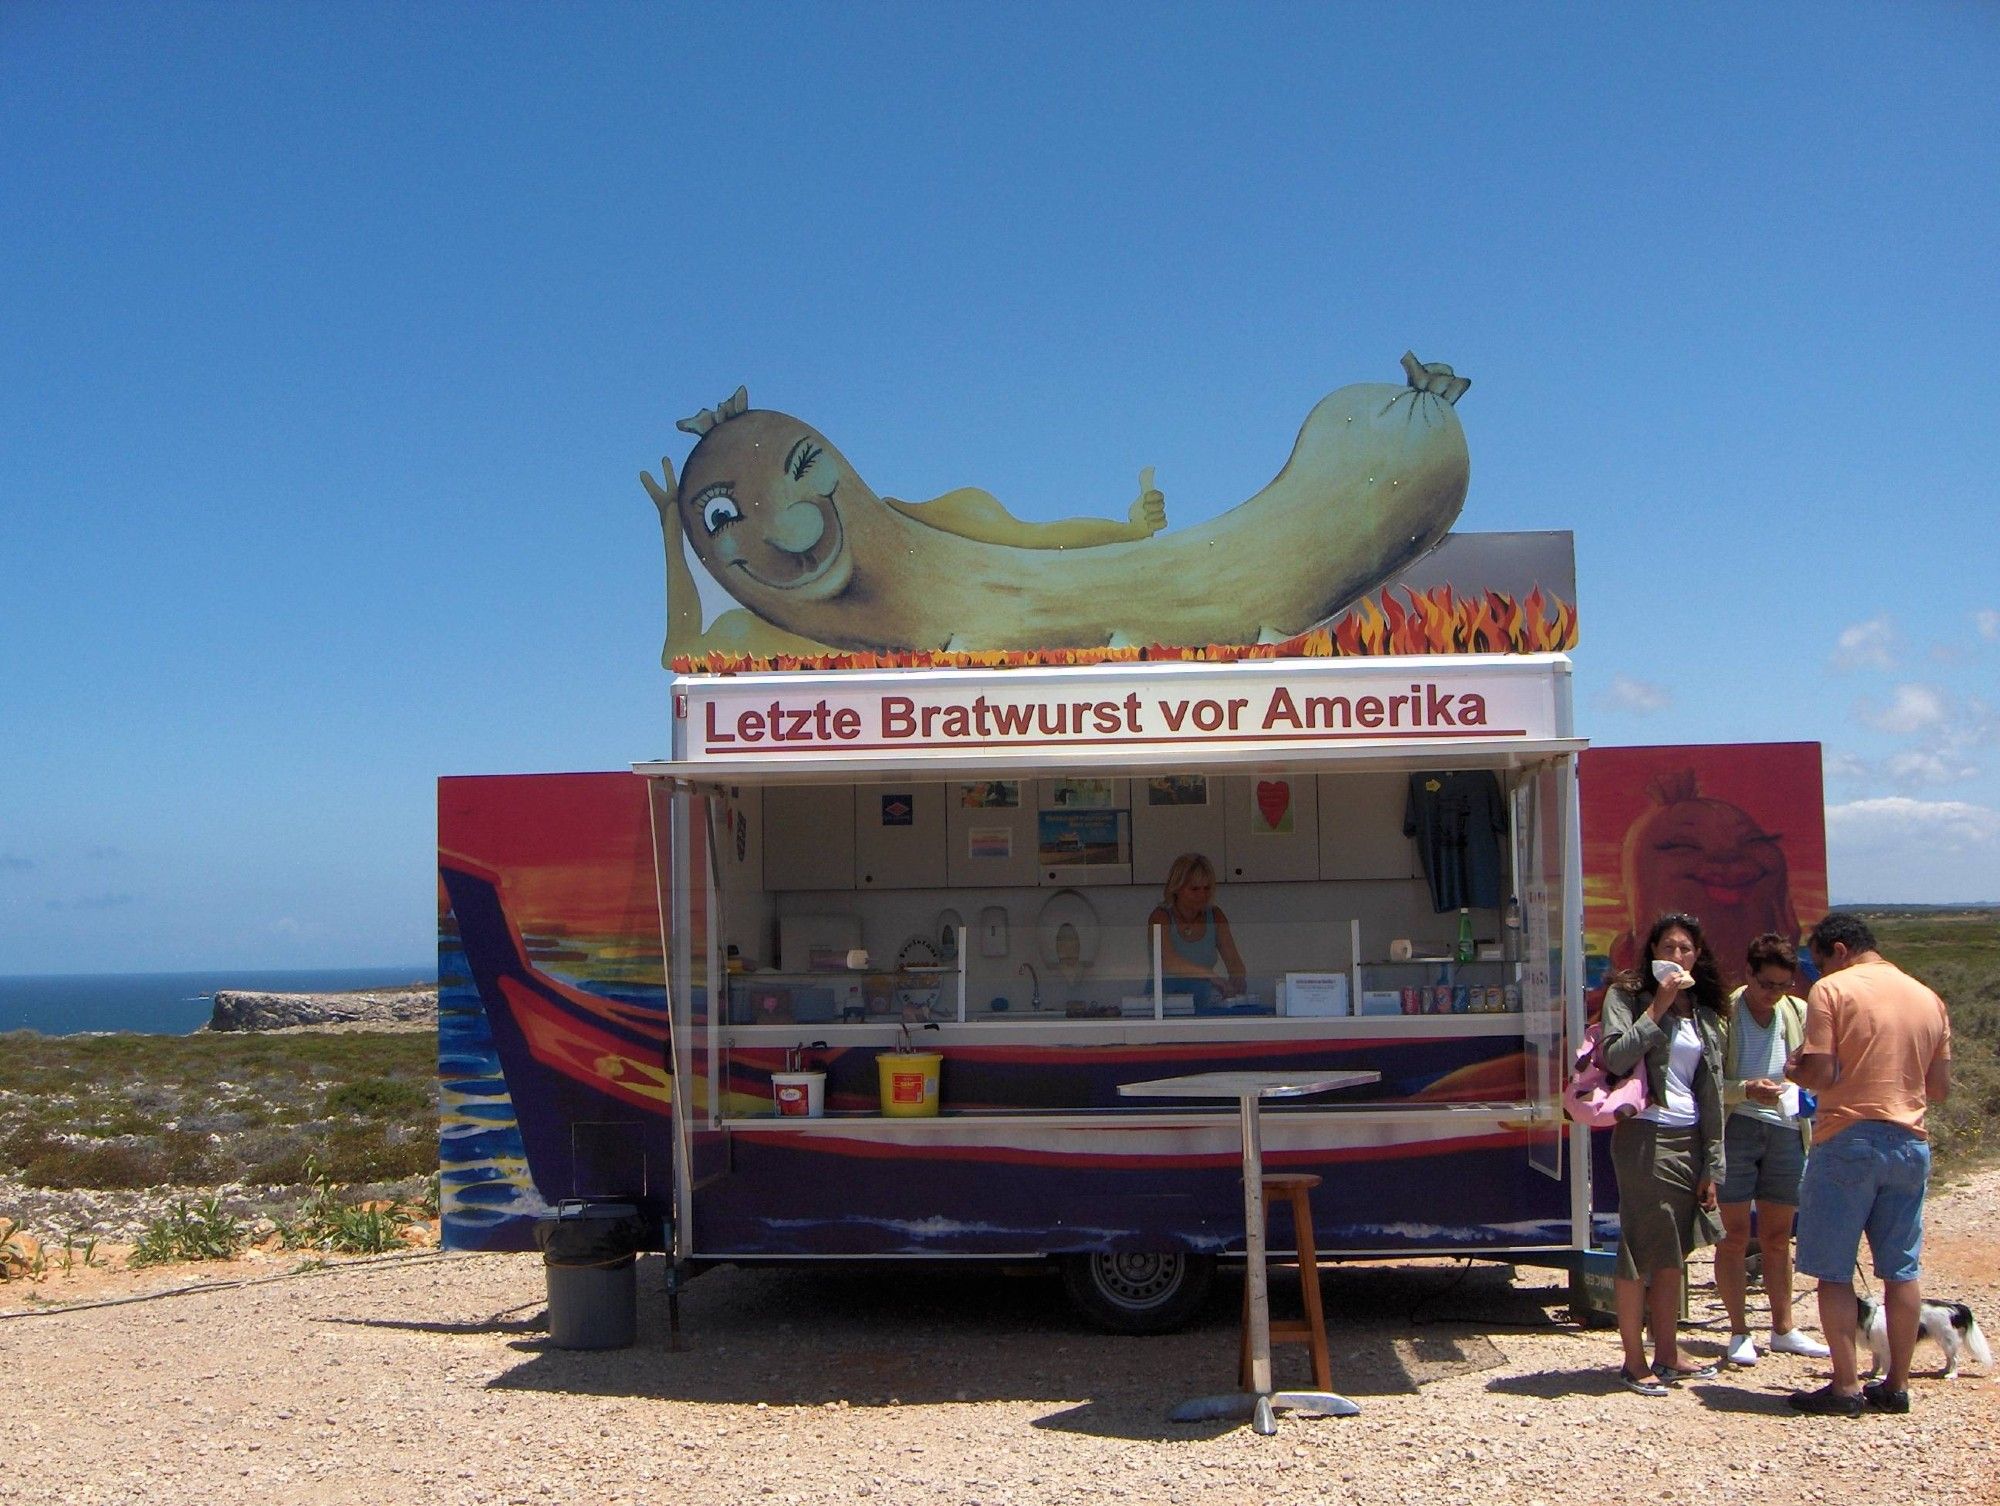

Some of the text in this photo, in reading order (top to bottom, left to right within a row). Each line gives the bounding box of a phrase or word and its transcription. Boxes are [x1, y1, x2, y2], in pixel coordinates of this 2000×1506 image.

[705, 684, 1488, 742] Letzte Bratwurst vor Amerika
